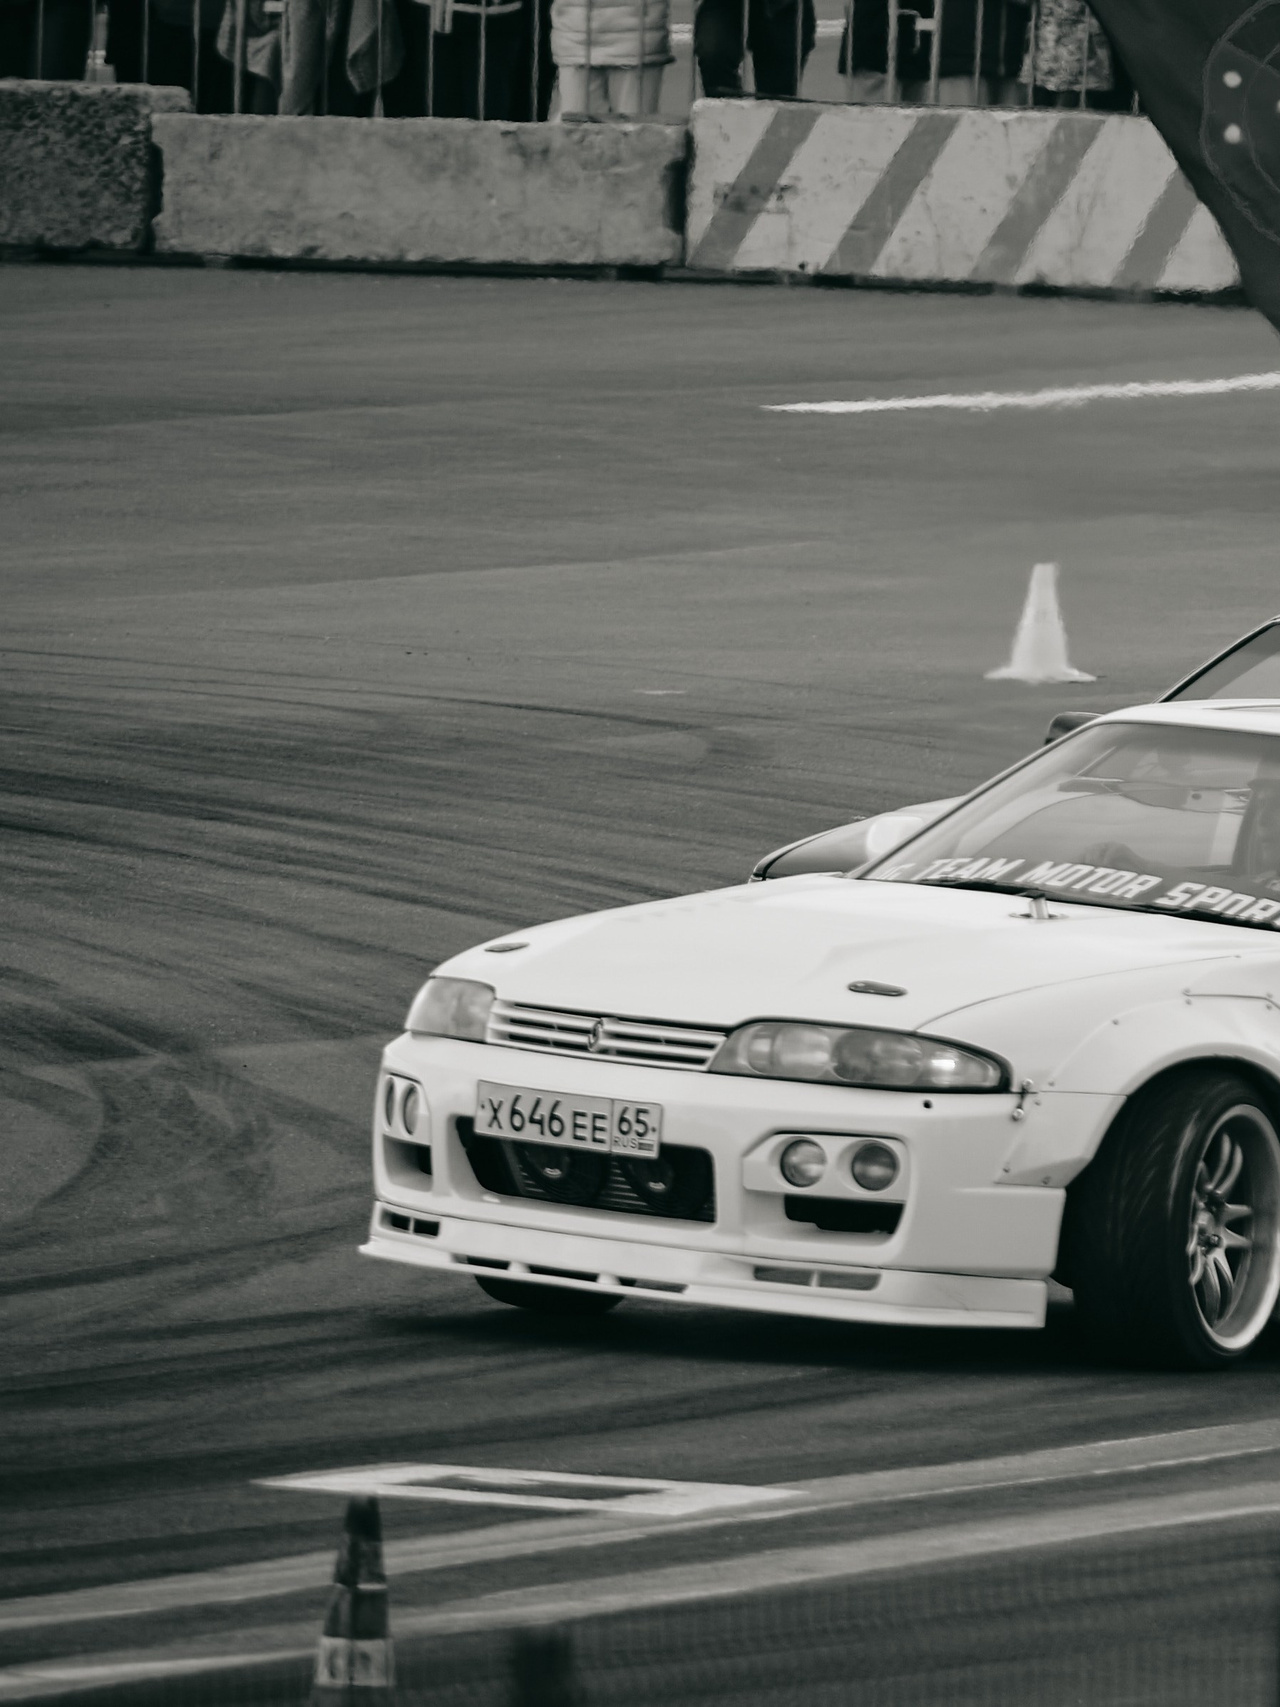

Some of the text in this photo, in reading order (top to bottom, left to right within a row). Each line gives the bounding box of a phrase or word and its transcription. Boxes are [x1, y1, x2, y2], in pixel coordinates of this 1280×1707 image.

[911, 857, 1026, 881] TEAM
[1014, 861, 1163, 899] MOTOR
[618, 1106, 651, 1138] 65
[612, 1136, 638, 1149] RUS
